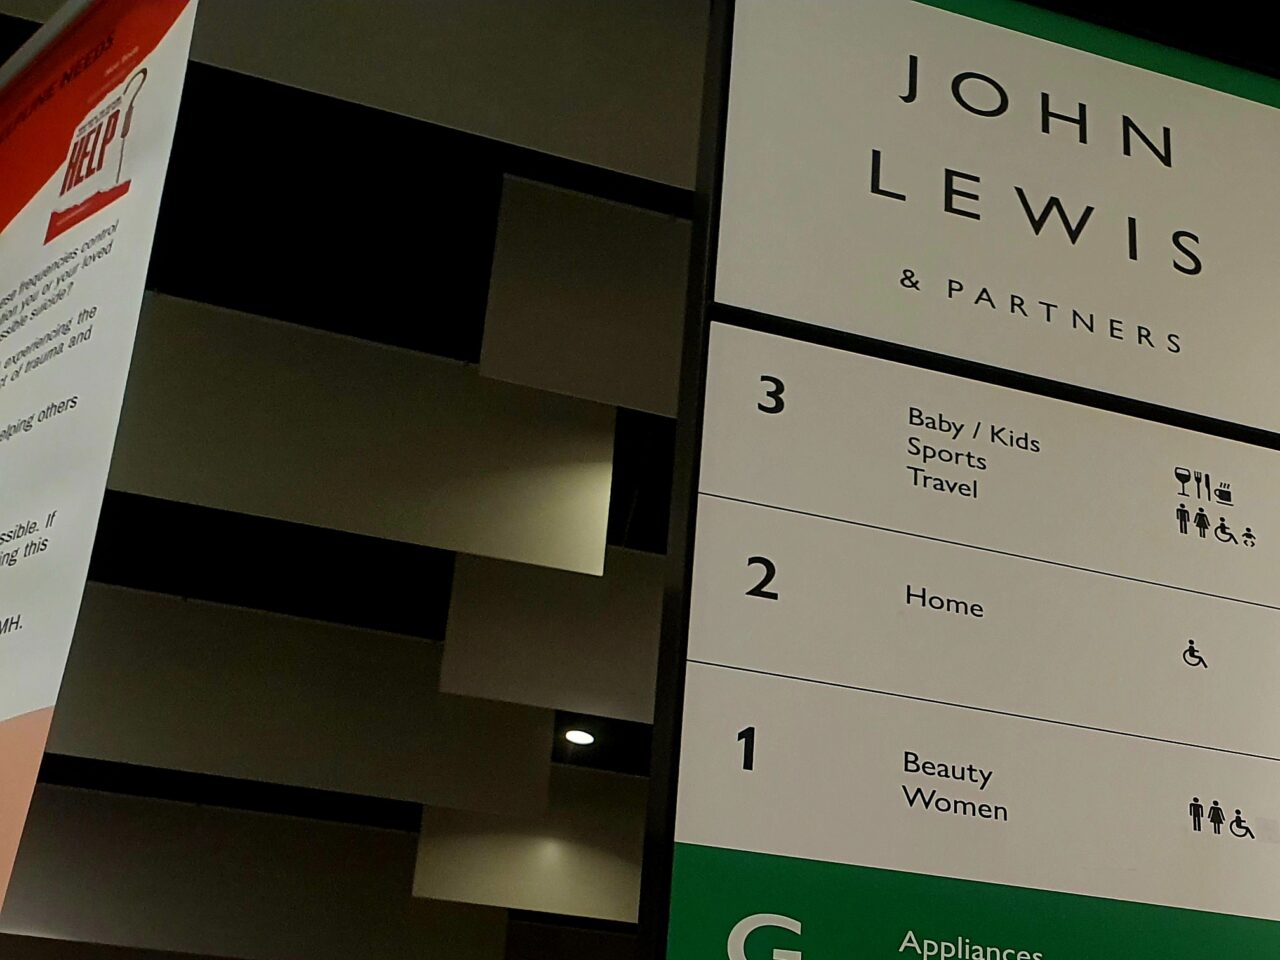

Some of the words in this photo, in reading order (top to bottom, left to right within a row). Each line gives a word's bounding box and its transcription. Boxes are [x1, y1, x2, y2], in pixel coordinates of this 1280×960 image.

[899, 54, 1174, 168] JOHN
[870, 149, 1203, 276] LEWIS
[77, 306, 97, 324] the
[899, 268, 920, 290] &
[947, 278, 1182, 354] PARTNERS
[25, 343, 64, 373] trauma
[68, 325, 92, 348] and
[38, 395, 78, 423] others
[757, 375, 786, 414] 3
[908, 406, 965, 440] Baby
[990, 425, 1041, 453] Kids
[907, 436, 988, 471] Sports
[907, 466, 978, 499] Travel
[46, 510, 58, 529] If
[24, 536, 48, 558] this
[745, 555, 779, 599] 2
[904, 584, 985, 619] Home
[736, 726, 756, 771] 1
[903, 751, 994, 790] Beauty
[903, 785, 1009, 822] Women
